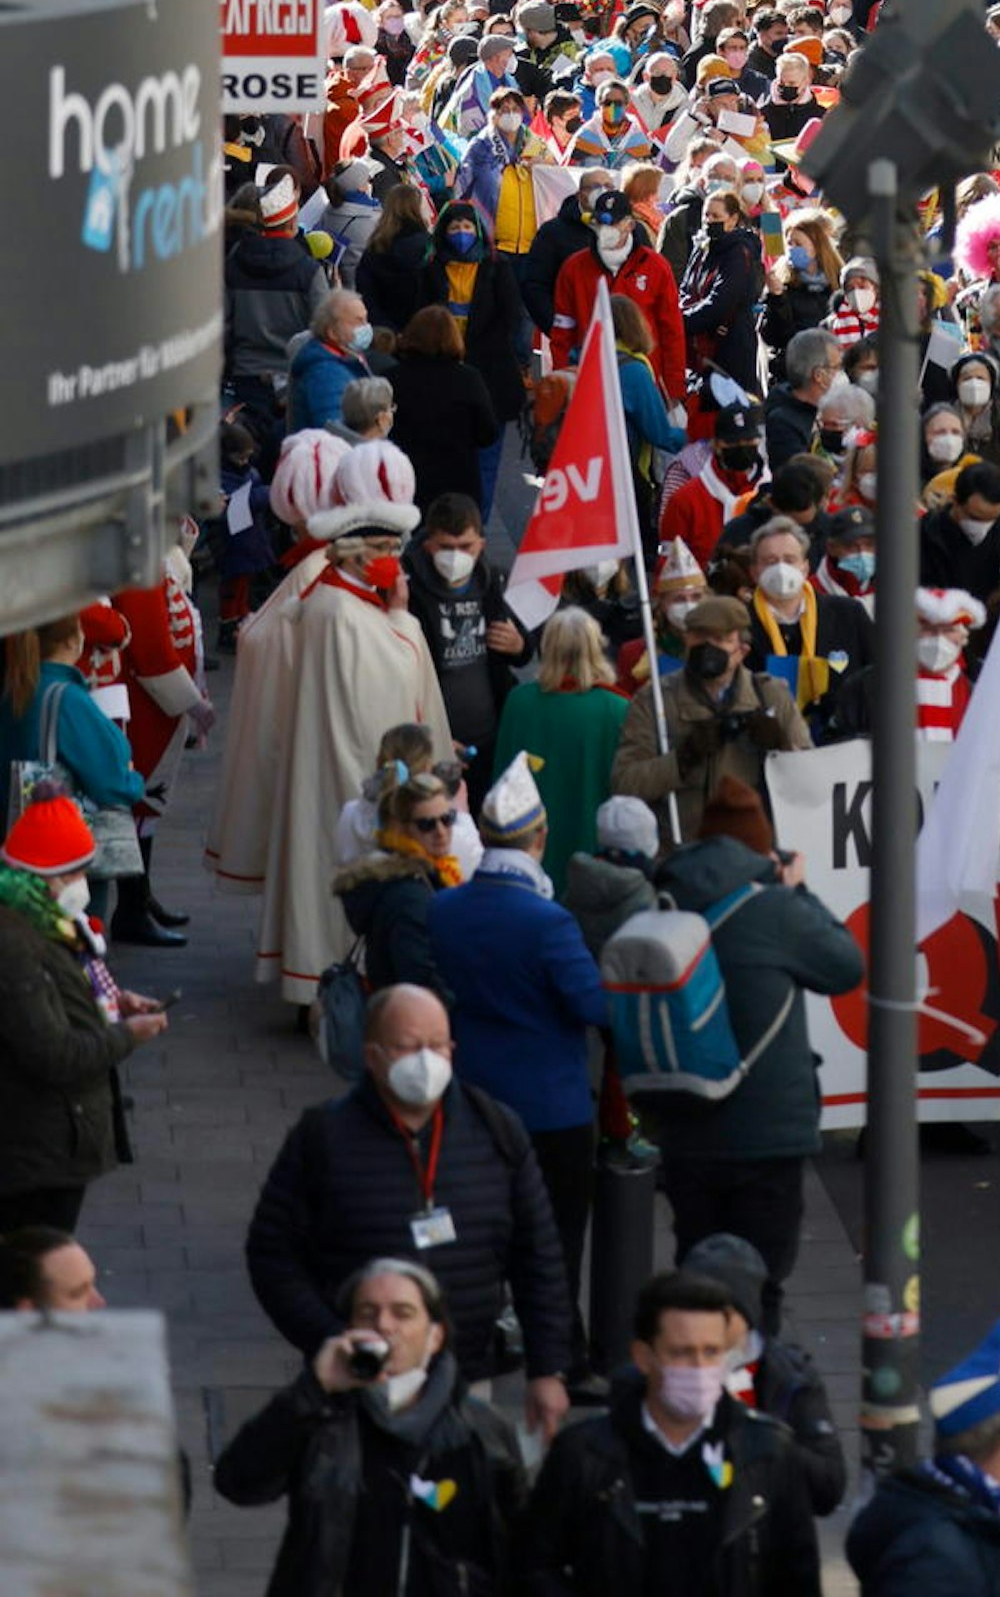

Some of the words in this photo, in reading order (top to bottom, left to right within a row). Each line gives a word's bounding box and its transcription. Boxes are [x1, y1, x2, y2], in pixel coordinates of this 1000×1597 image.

[49, 62, 201, 179] home
[48, 372, 76, 405] Ihr
[78, 357, 138, 398] Partner
